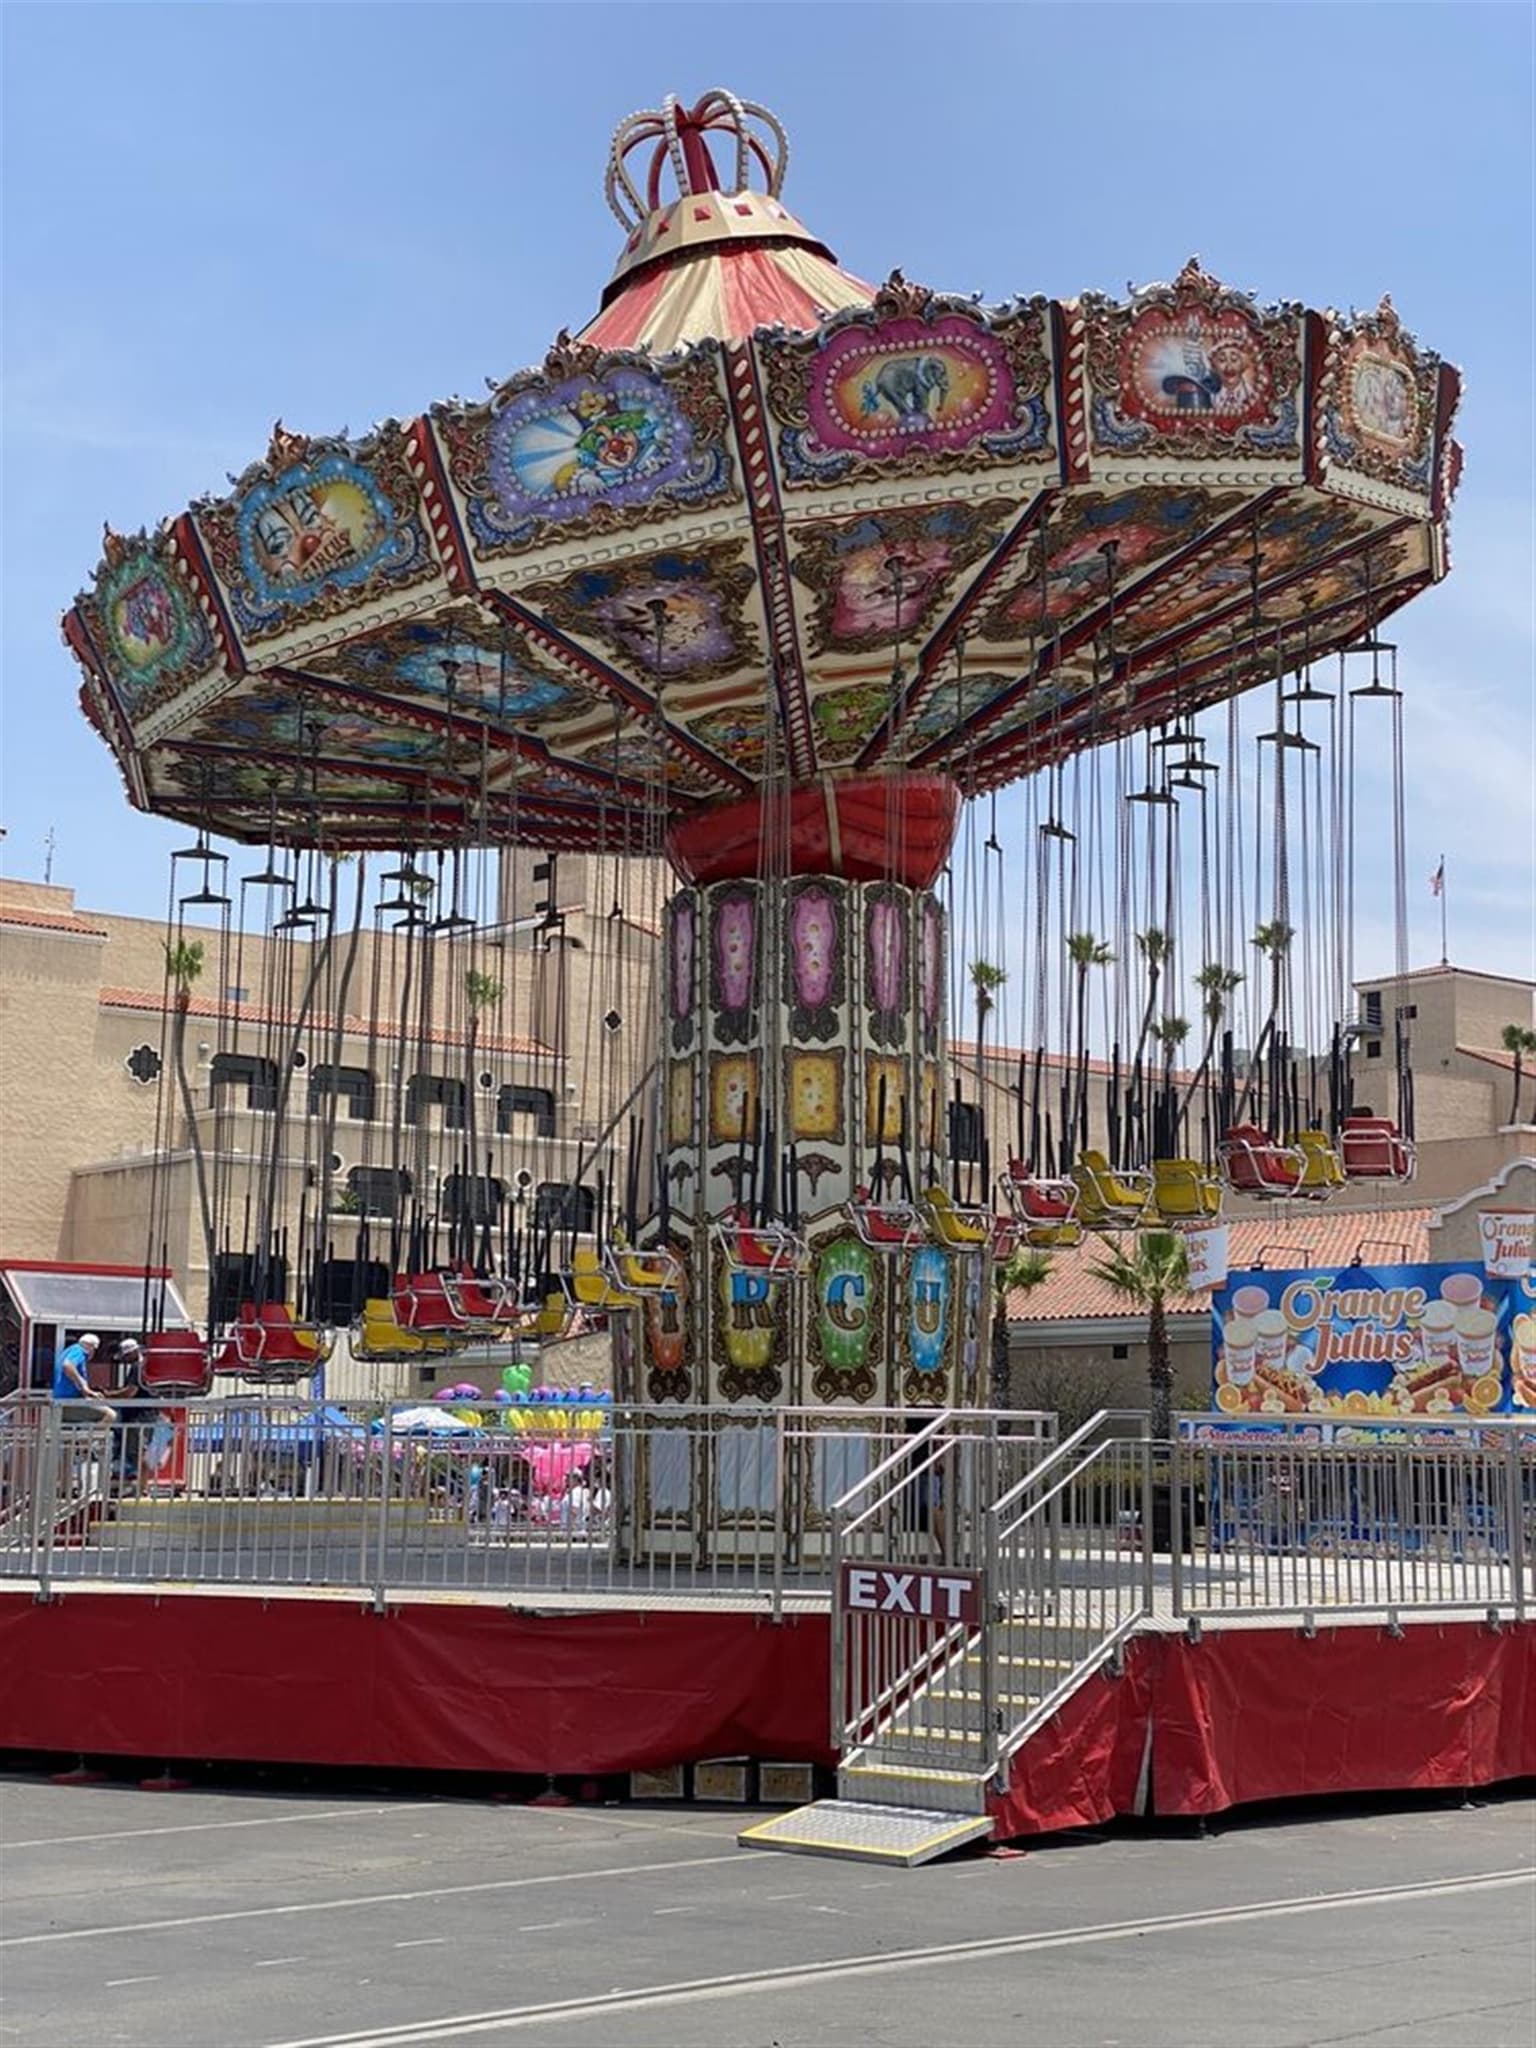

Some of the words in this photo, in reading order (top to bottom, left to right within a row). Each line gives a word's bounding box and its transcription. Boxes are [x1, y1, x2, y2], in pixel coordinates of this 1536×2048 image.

[302, 530, 350, 580] CIRCUS
[1281, 1278, 1427, 1330] Orange
[1304, 1321, 1414, 1375] Julius
[848, 1569, 973, 1619] EXIT
